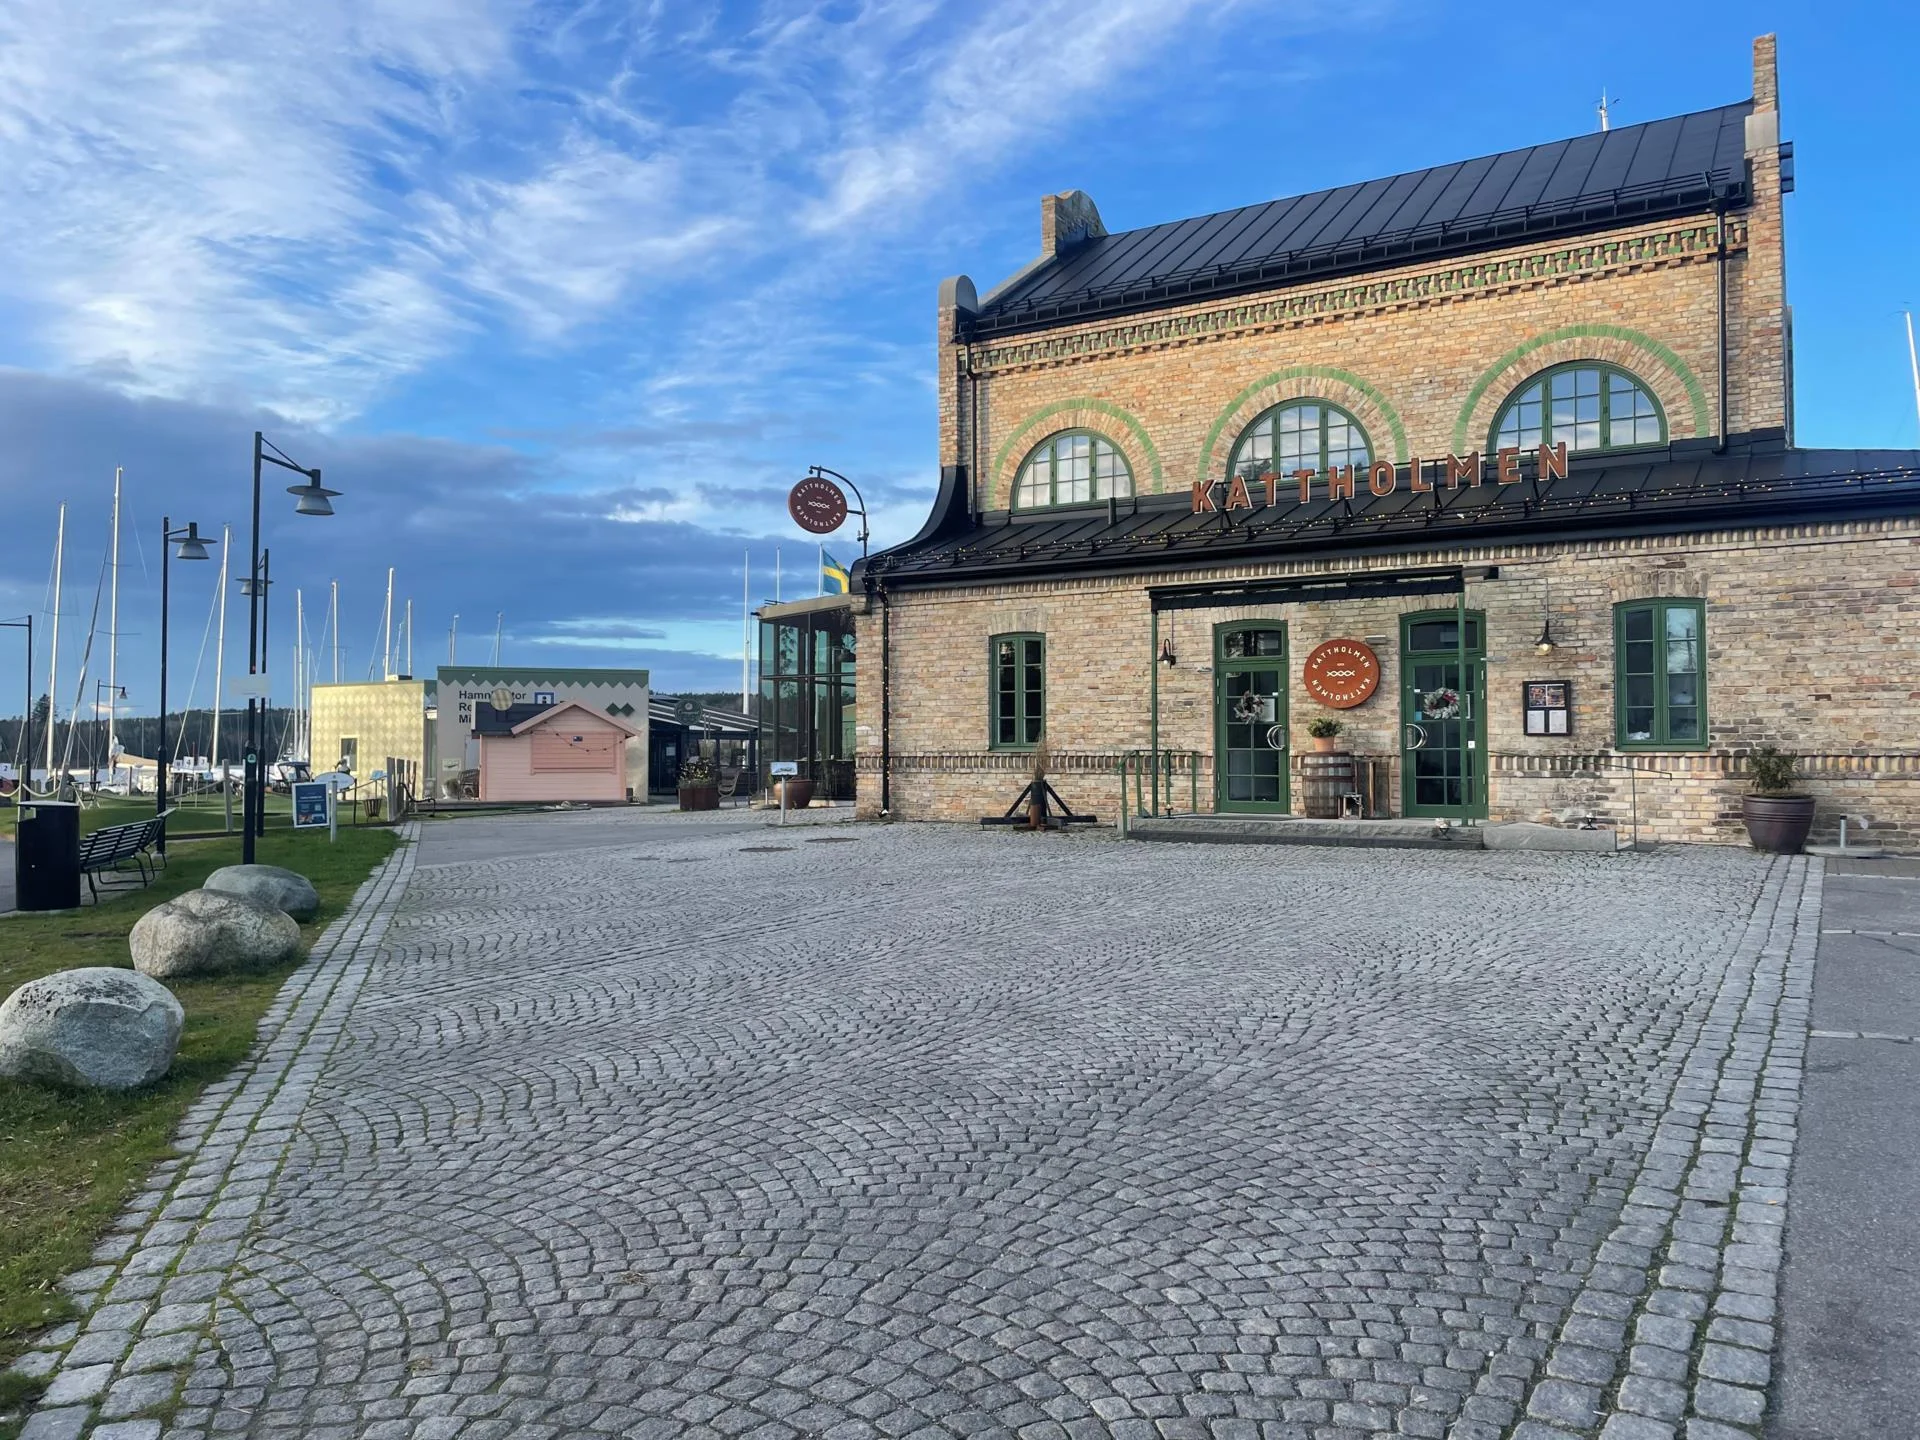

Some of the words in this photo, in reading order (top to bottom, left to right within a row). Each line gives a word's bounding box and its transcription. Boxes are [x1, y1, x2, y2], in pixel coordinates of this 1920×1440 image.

[1192, 441, 1568, 513] KATTHOLMEN
[796, 483, 841, 505] KATTHOLMEN
[1312, 646, 1371, 669] KATTHOLMEN
[459, 690, 527, 700] Hamntor
[1312, 678, 1371, 701] KATTHOLMEN
